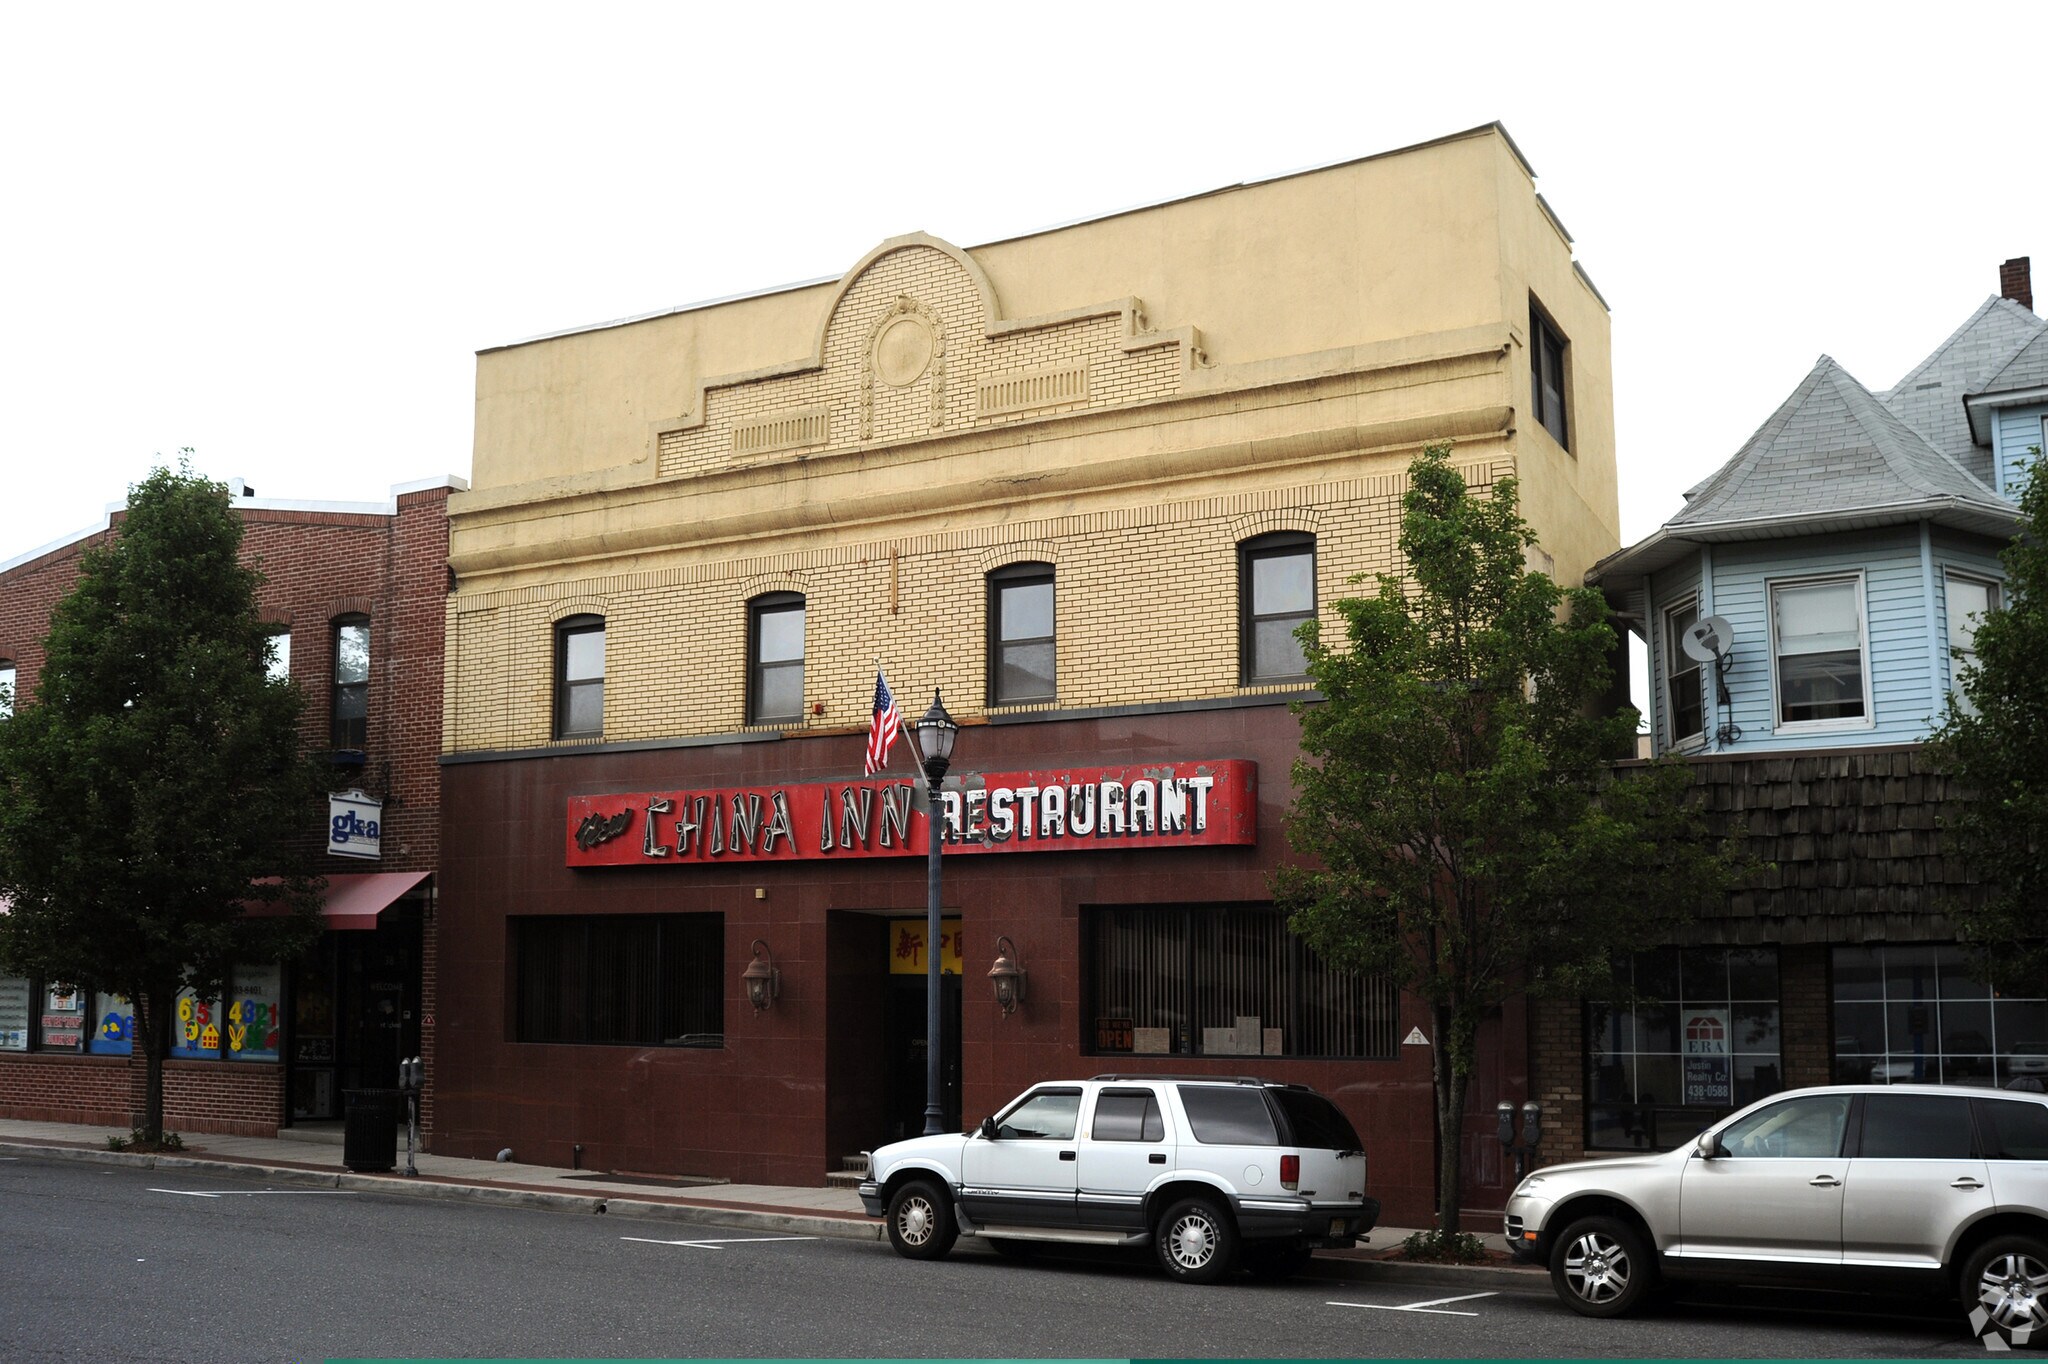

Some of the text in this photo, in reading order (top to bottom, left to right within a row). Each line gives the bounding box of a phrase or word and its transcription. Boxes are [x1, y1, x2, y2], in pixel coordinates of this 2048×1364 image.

[642, 791, 797, 858] CHINA
[820, 785, 914, 853] INN
[941, 776, 1214, 843] RESTAURANT
[1098, 1030, 1132, 1048] OPEN
[1688, 1041, 1724, 1053] ERA
[1687, 1060, 1711, 1070] Justin
[1687, 1072, 1712, 1083] Realty
[1688, 1085, 1729, 1097] 438-0588
